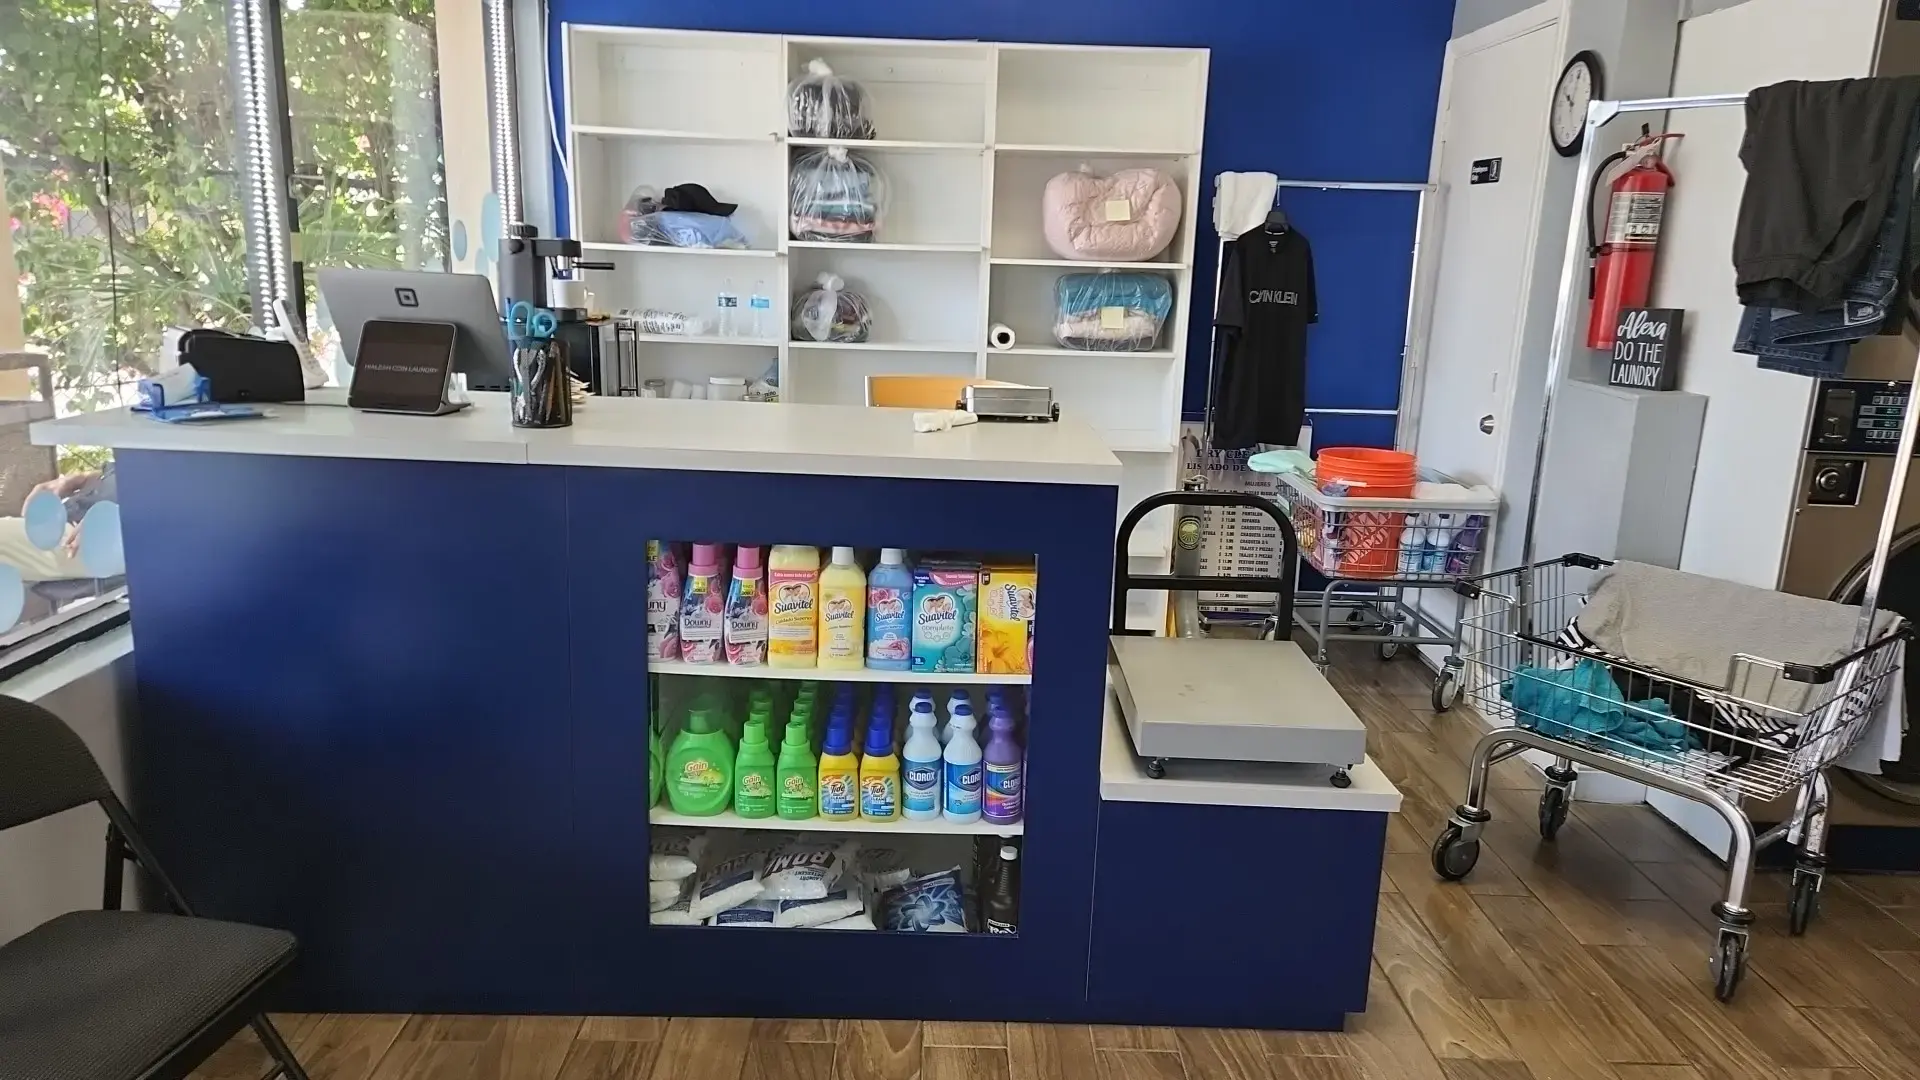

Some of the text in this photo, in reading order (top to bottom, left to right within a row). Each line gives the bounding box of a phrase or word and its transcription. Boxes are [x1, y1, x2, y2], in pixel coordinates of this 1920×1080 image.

[1617, 310, 1668, 340] Alexa
[1614, 340, 1664, 364] DO THE
[1610, 363, 1660, 387] LAUNDRY
[1186, 462, 1228, 471] LISADO
[1346, 526, 1388, 564] DEPOT
[774, 598, 814, 614] Suavitel
[1005, 583, 1020, 621] Suavitel
[825, 611, 854, 622] Suavitel
[875, 610, 905, 622] Suavitel
[918, 610, 957, 624] Suavitel
[684, 619, 711, 628] Downy
[732, 622, 759, 630] Downy
[685, 761, 708, 772] Gain
[742, 776, 761, 784] Gain
[784, 777, 804, 787] Gain
[909, 772, 935, 782] CLOROX
[831, 784, 845, 794] Tide
[871, 786, 885, 794] Tide
